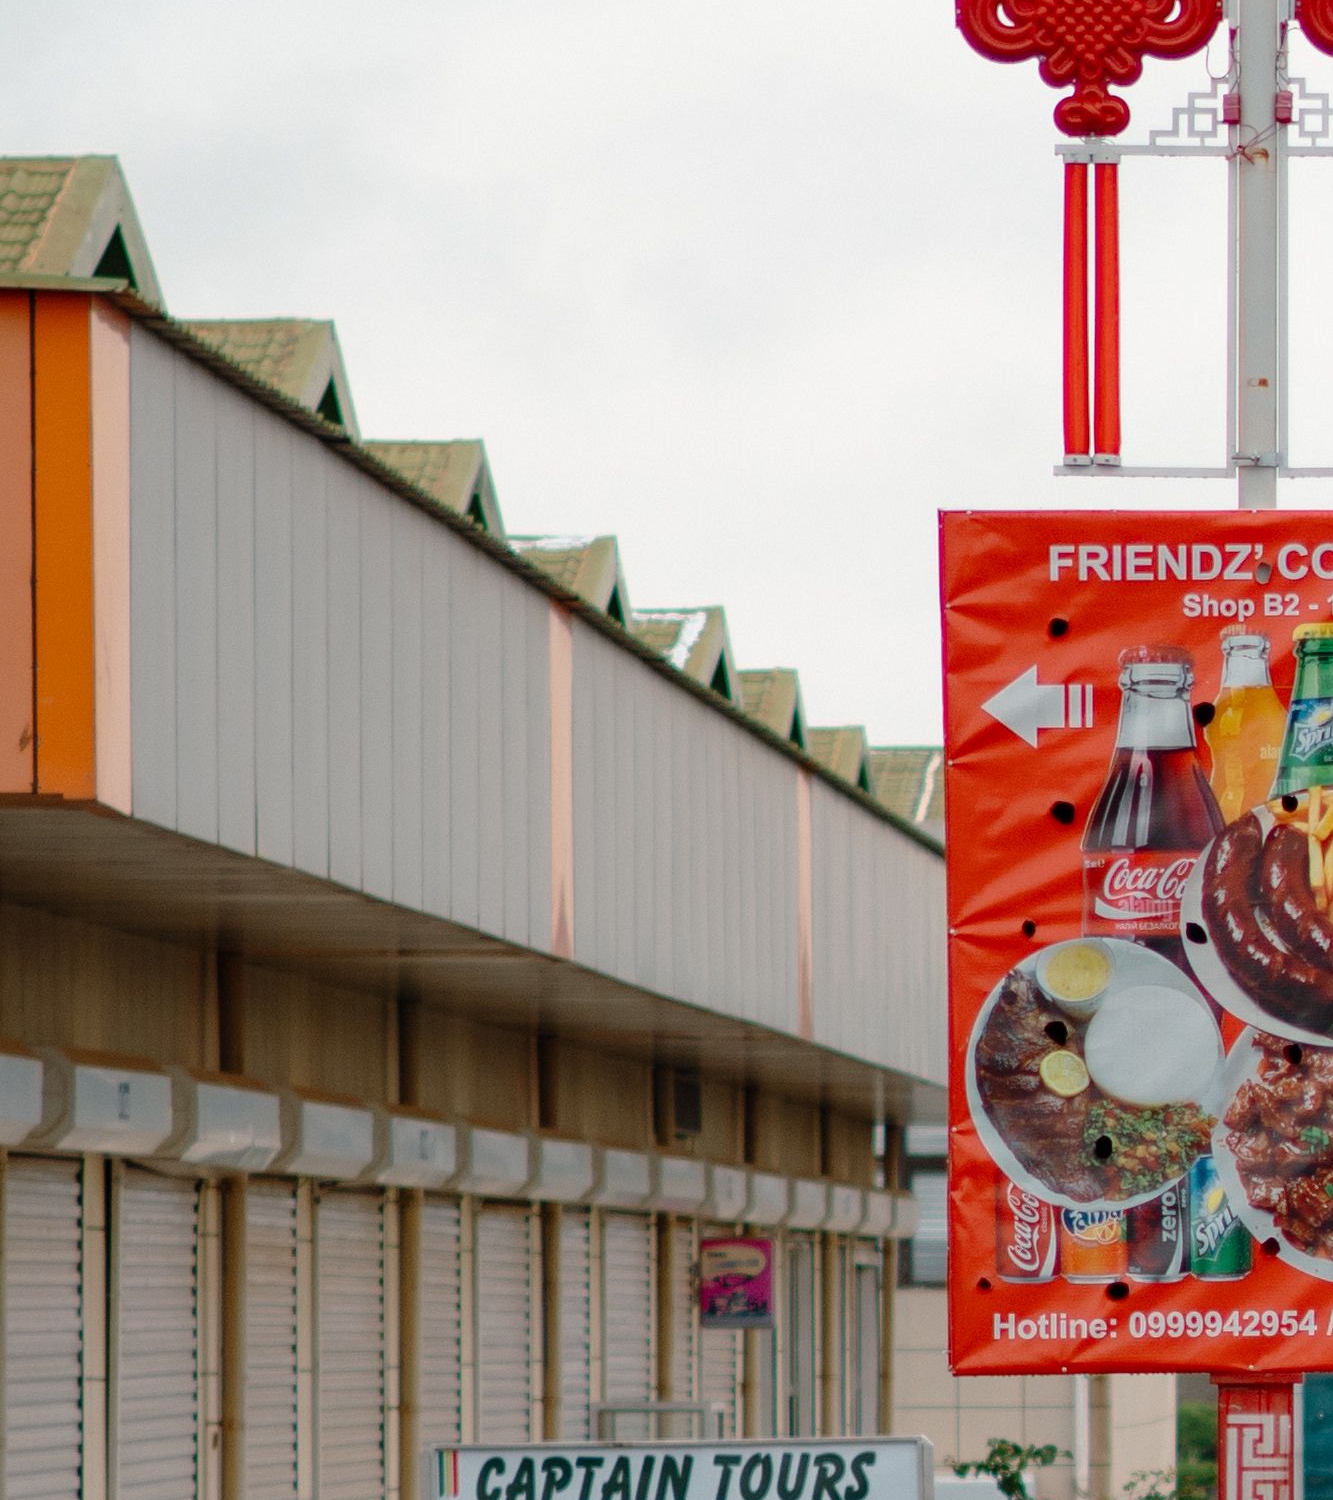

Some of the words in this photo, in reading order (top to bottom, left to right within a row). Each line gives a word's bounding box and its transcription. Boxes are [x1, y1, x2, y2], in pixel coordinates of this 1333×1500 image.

[1182, 593, 1255, 621] Shop
[1263, 593, 1300, 617] B2
[1162, 1191, 1176, 1242] zero
[1196, 1204, 1239, 1256] Spri
[993, 1313, 1117, 1340] Hotline:
[1129, 1309, 1317, 1338] 0999942954
